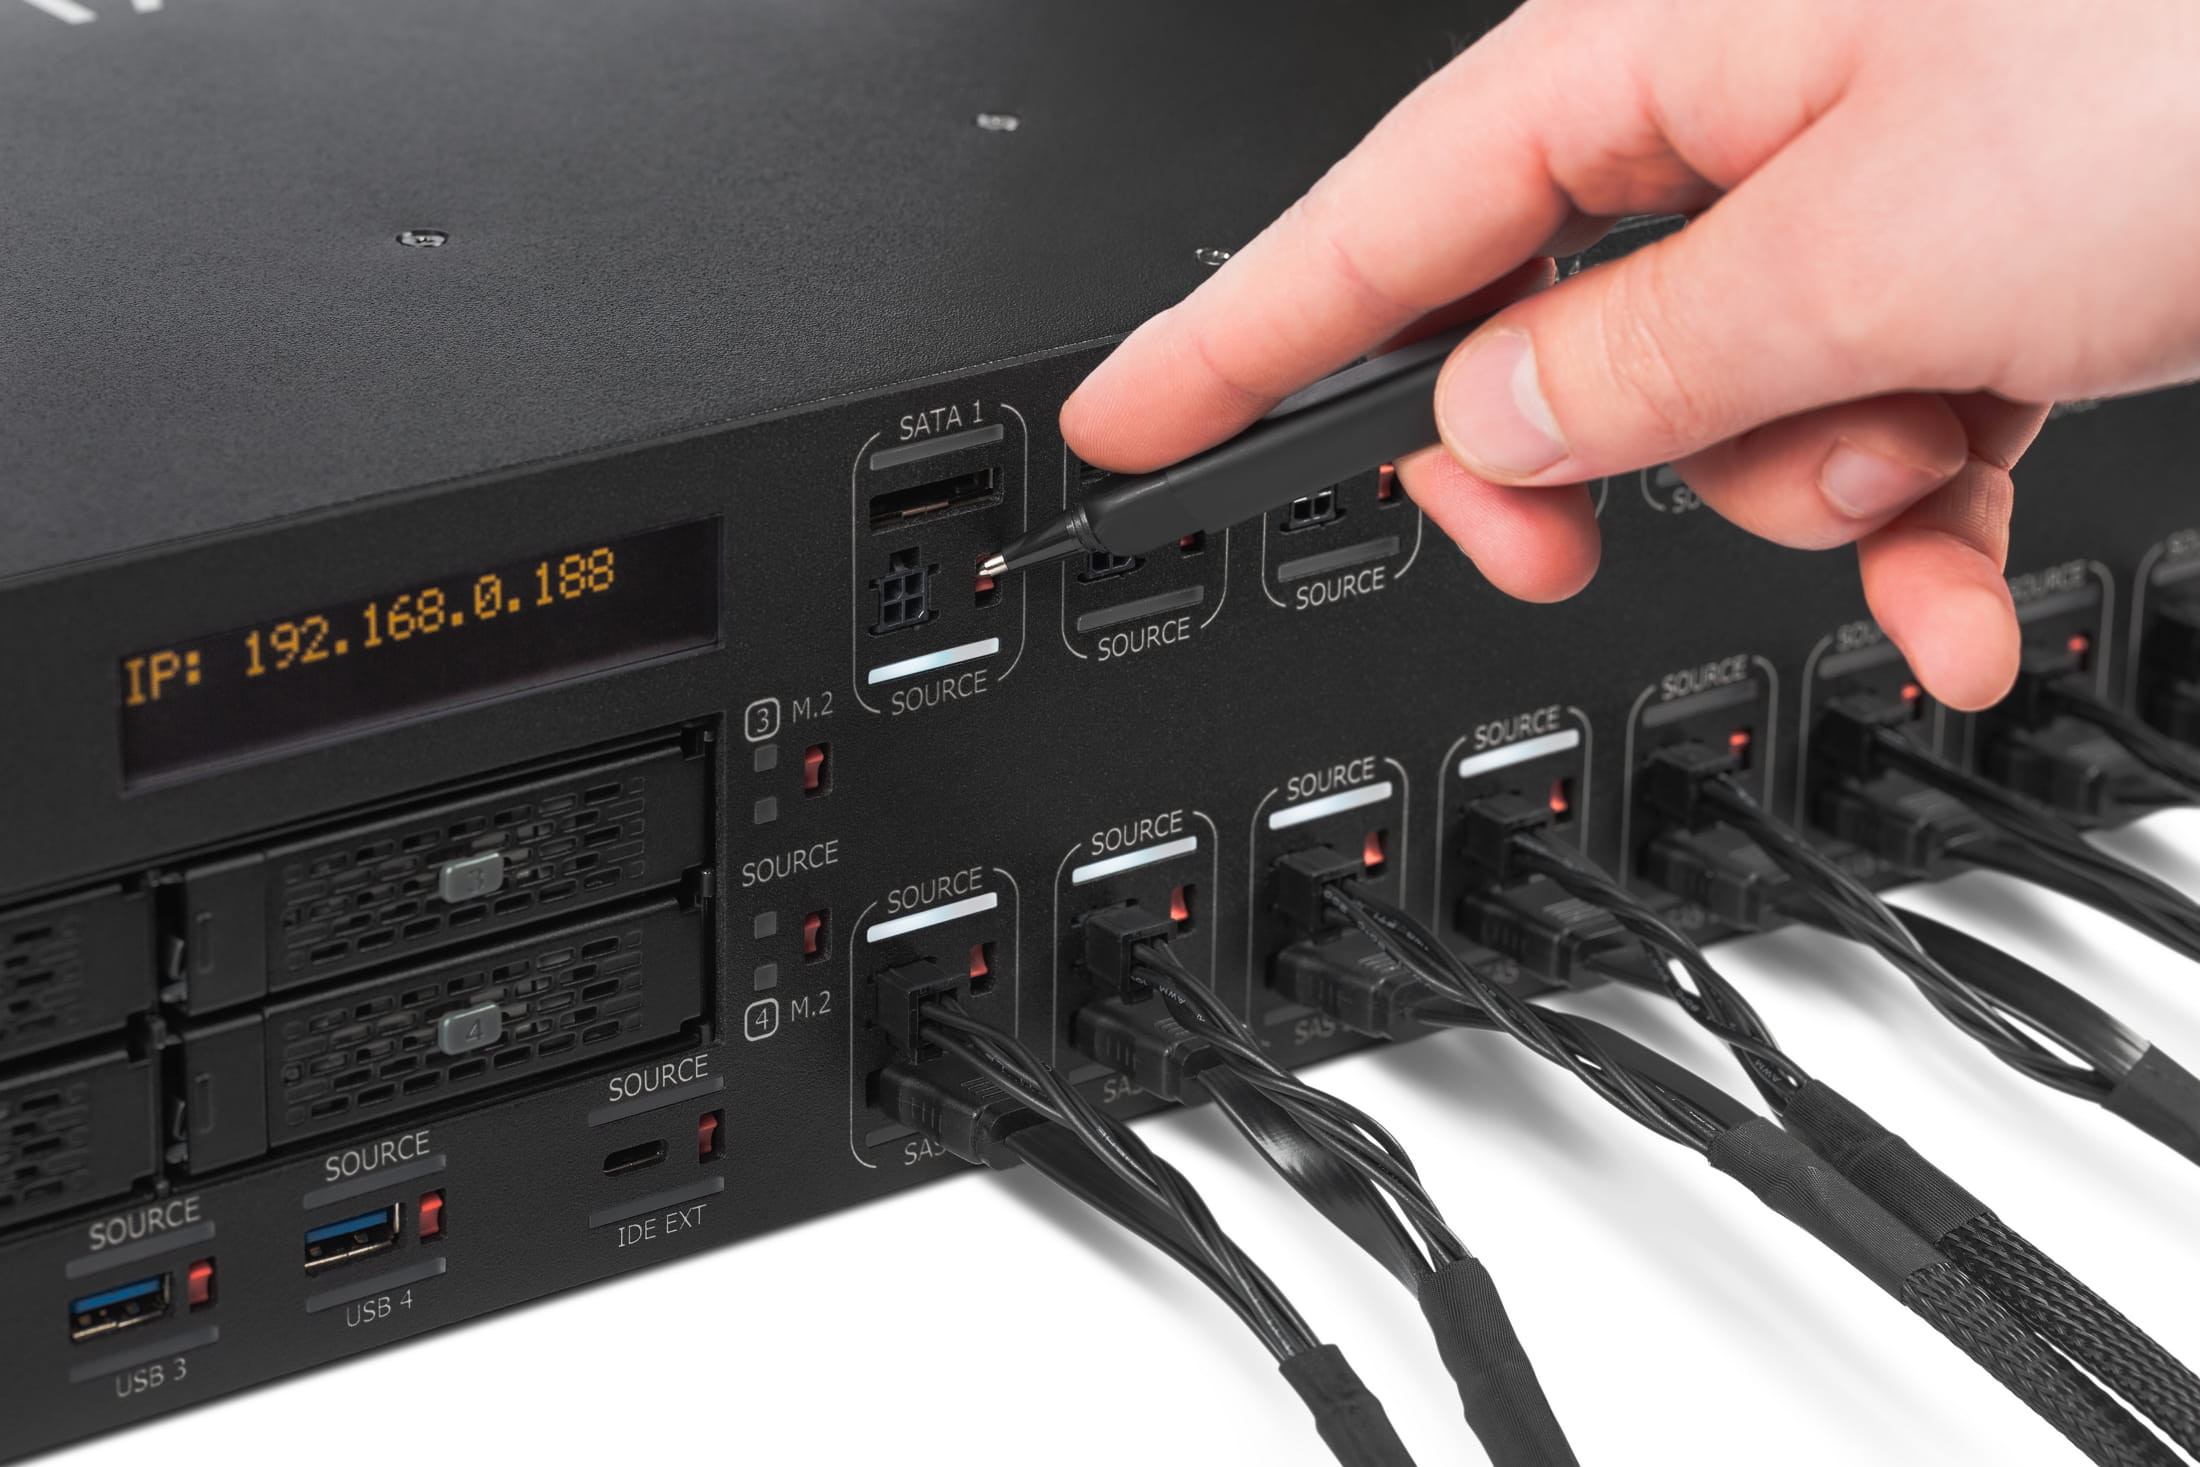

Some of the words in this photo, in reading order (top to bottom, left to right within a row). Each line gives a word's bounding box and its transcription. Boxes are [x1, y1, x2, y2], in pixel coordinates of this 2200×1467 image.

[899, 404, 963, 441] SATA
[972, 399, 984, 424] 1
[1296, 565, 1386, 610] SOURCE
[124, 650, 201, 705] IP:
[244, 547, 616, 676] 192.168.0.188
[1097, 616, 1190, 662] SOURCE
[891, 669, 988, 716] SOURCE
[1661, 653, 1749, 702] SOURCE
[792, 691, 834, 723] M.2
[1473, 704, 1562, 751] SOURCE
[1286, 755, 1376, 802] SOURCE
[1091, 808, 1183, 856] SOURCE
[742, 839, 839, 887] SOURCE
[887, 866, 983, 914] SOURCE
[791, 990, 832, 1022] M.2
[465, 1018, 482, 1042] 4
[608, 1054, 709, 1102] SOURCE
[325, 1130, 431, 1182] SOURCE
[88, 1195, 201, 1251] SOURCE
[617, 1218, 657, 1248] IDE
[665, 1204, 708, 1234] EXT
[345, 1296, 392, 1328] USB
[399, 1289, 413, 1309] 4
[115, 1364, 165, 1398] USB
[172, 1357, 187, 1381] 3
